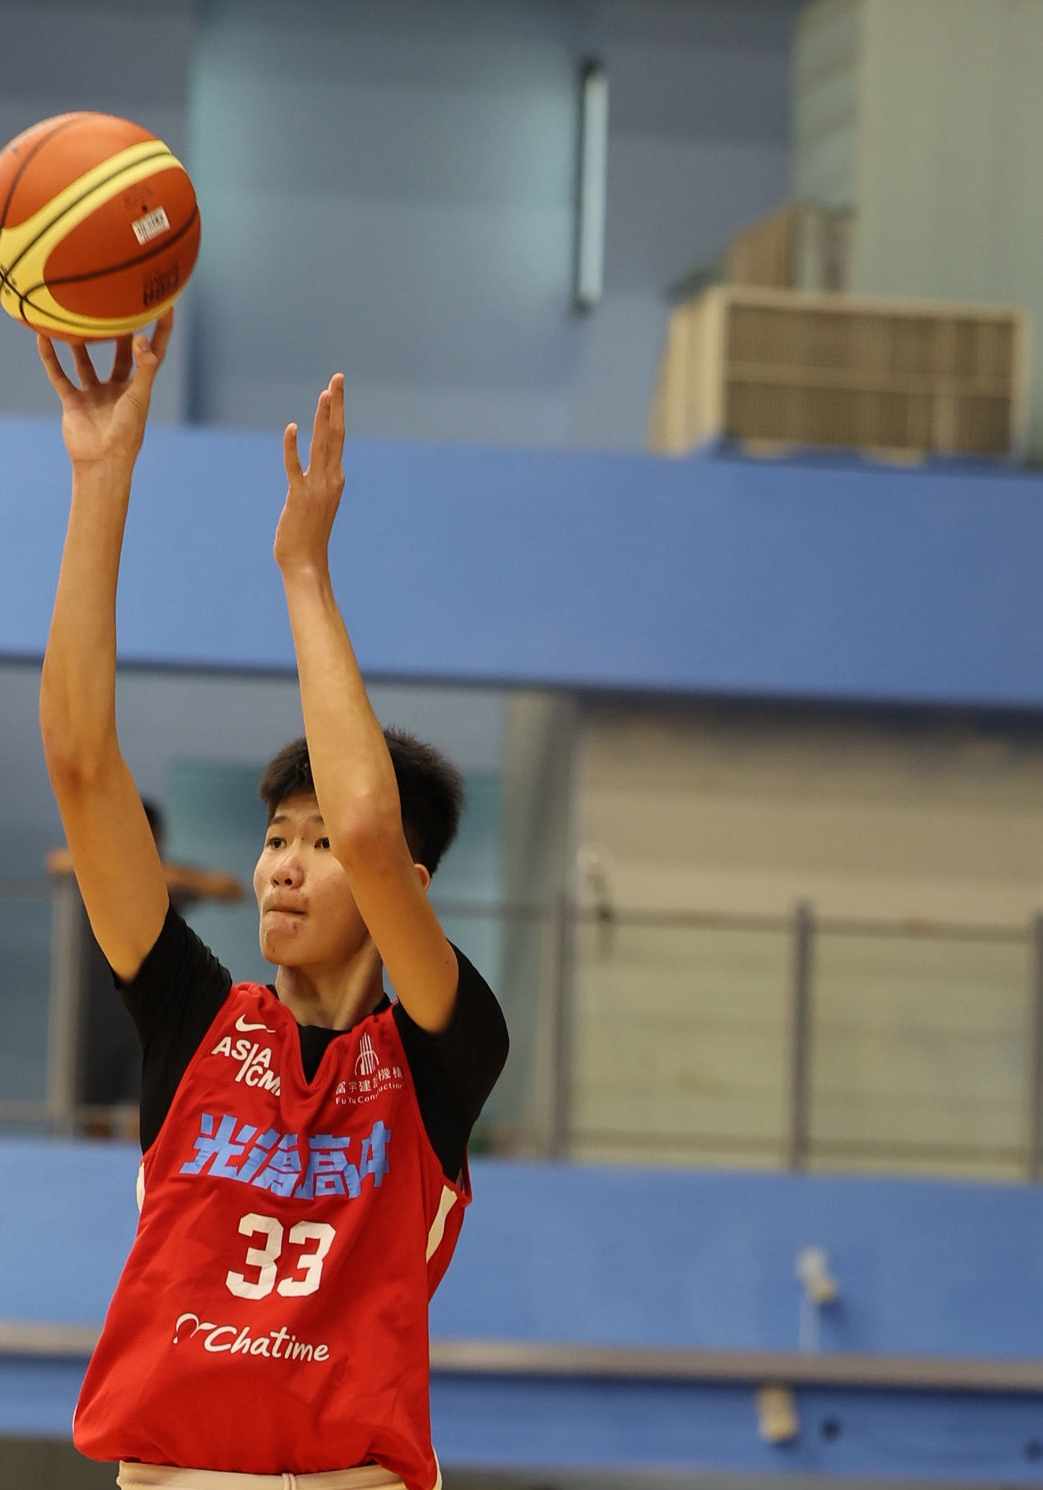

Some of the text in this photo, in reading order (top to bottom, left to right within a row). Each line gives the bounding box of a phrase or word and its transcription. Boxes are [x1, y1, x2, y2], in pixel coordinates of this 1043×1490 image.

[211, 1036, 272, 1070] ASIA
[225, 1212, 337, 1301] 33
[203, 1325, 331, 1362] Chatime
